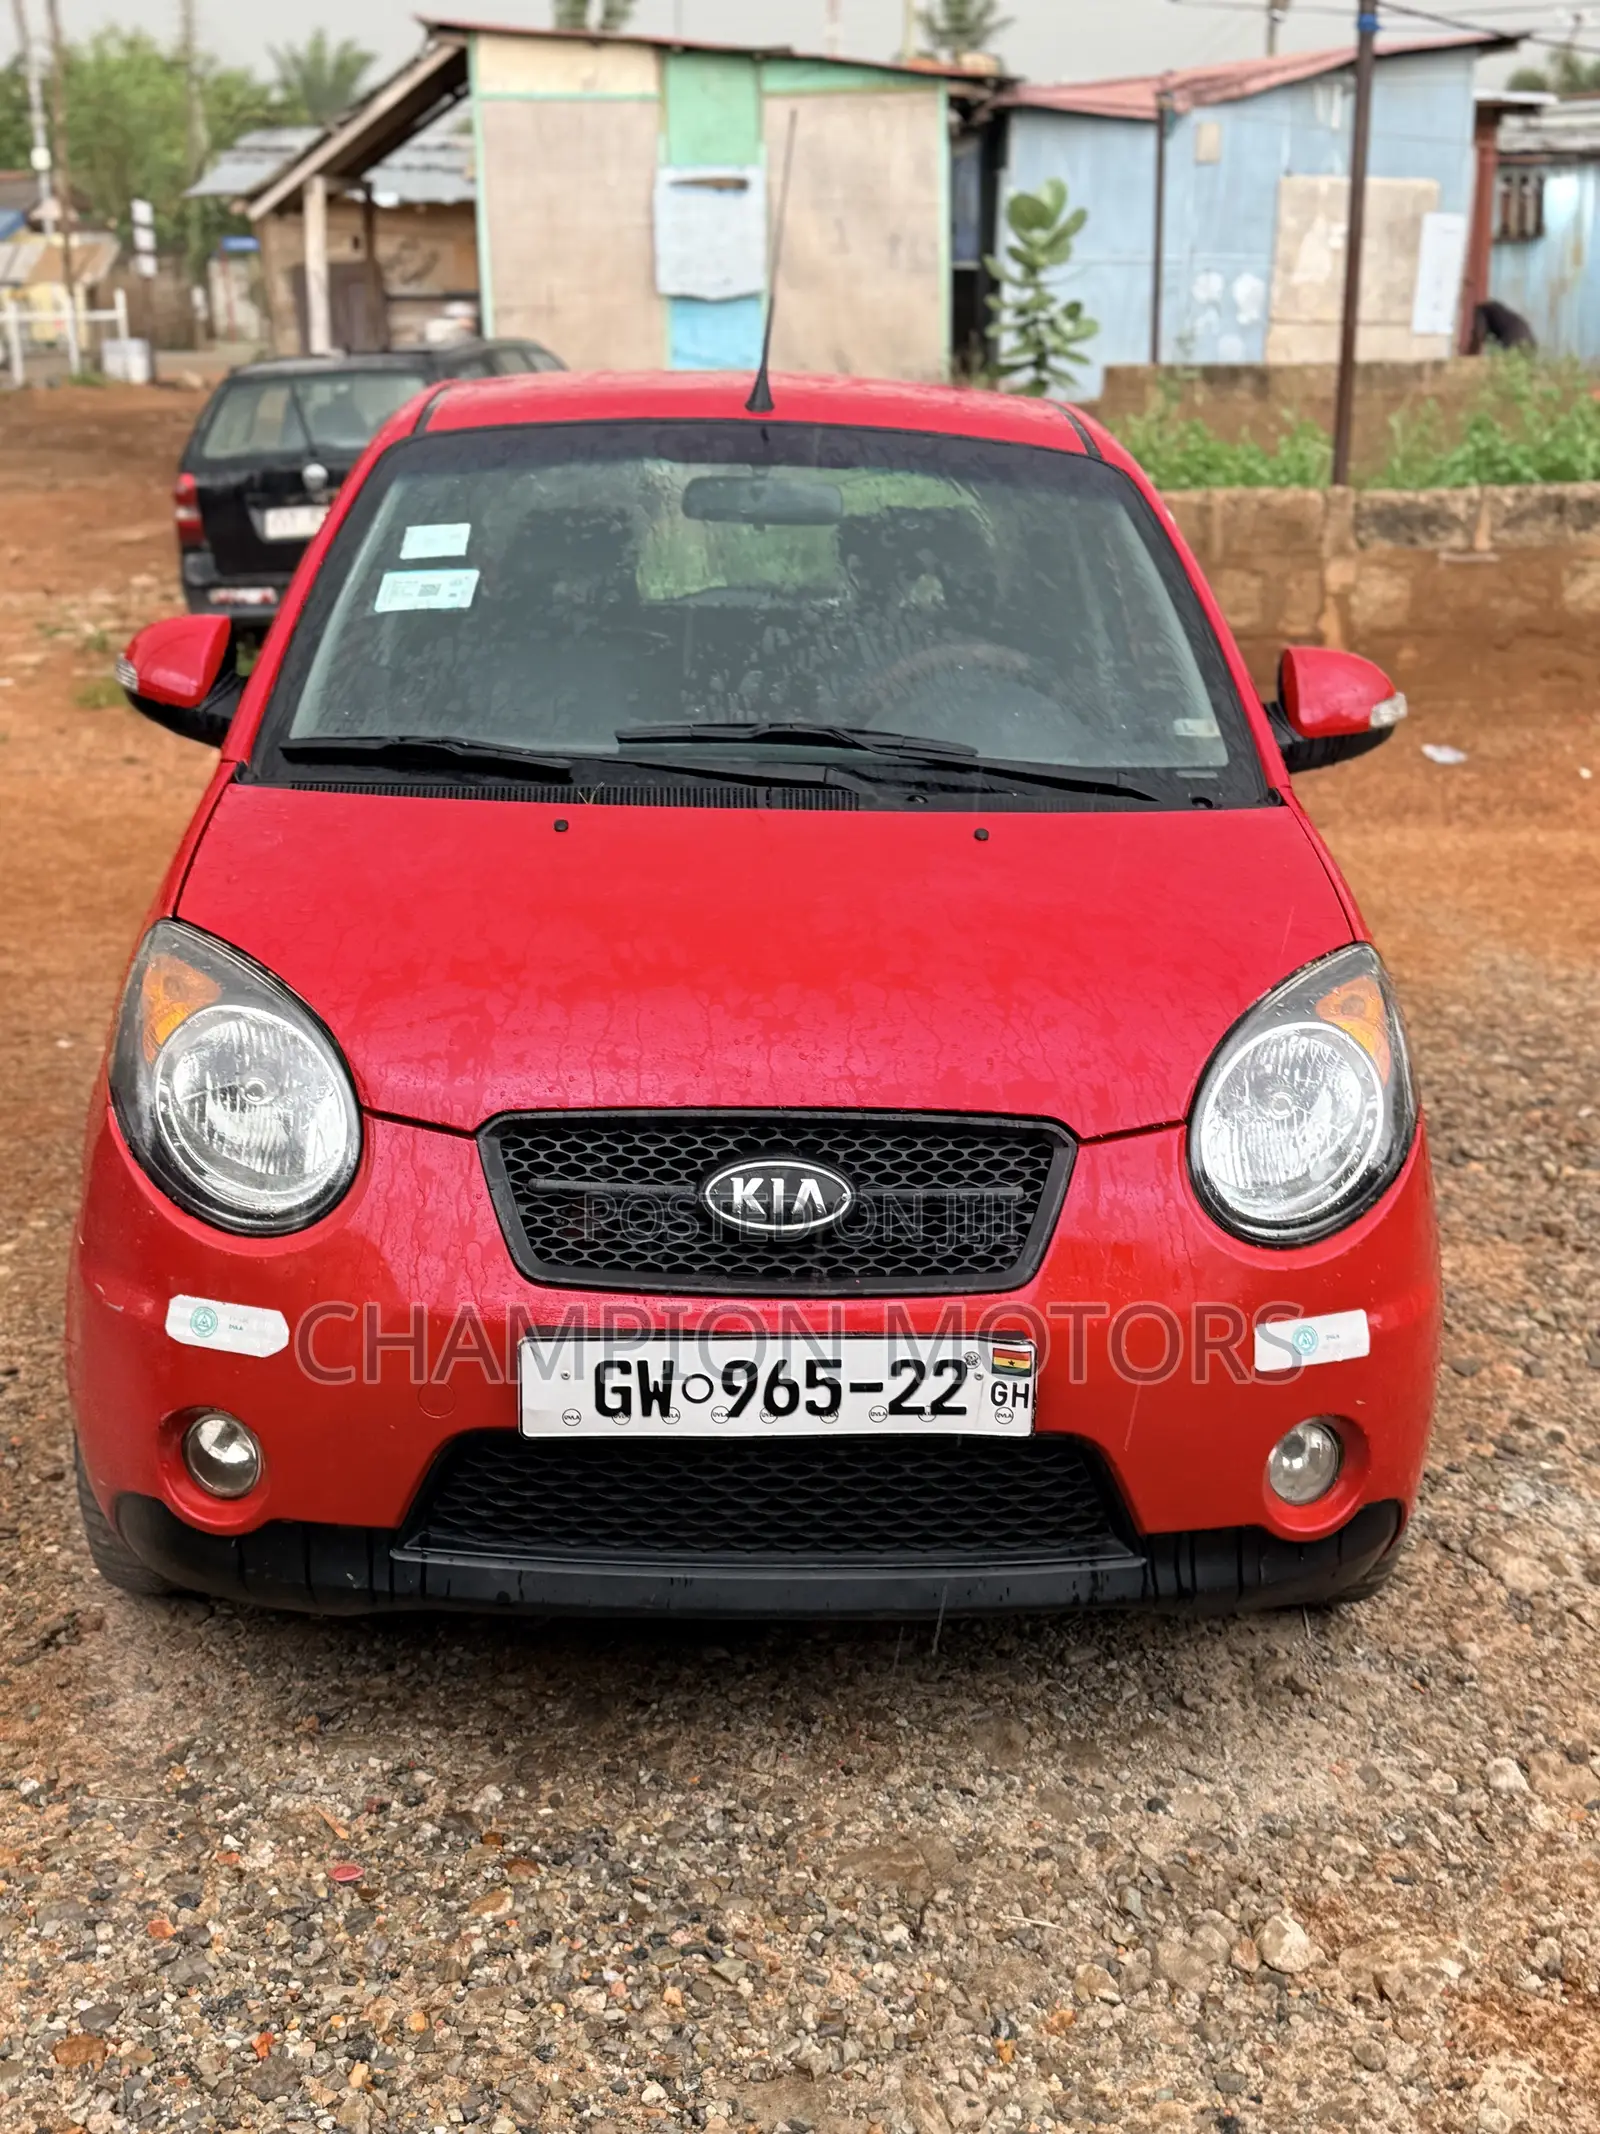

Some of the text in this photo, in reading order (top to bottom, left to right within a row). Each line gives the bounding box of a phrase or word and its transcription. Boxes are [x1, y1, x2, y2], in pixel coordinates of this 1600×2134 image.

[731, 1176, 828, 1215] KIA
[594, 1358, 967, 1418] GW 965-22
[990, 1380, 1030, 1409] GH
